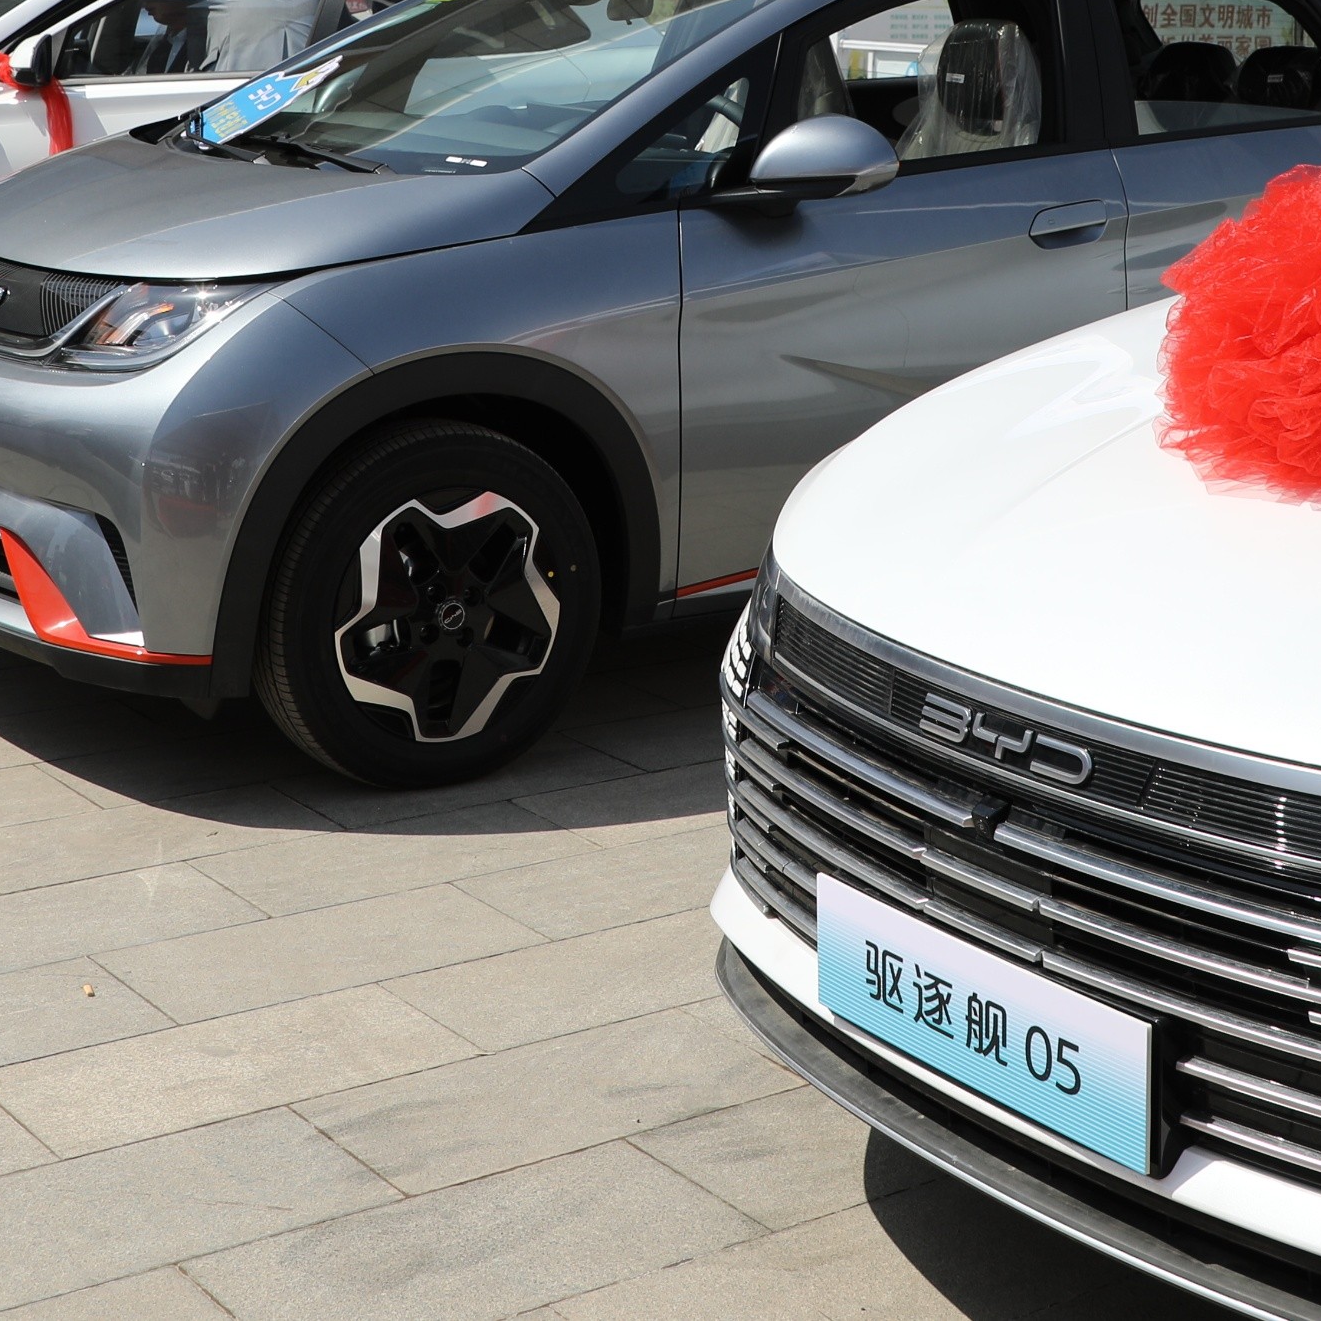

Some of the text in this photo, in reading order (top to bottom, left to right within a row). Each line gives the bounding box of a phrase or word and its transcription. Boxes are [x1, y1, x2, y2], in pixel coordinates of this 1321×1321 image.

[918, 691, 1093, 785] BYD
[864, 938, 1083, 1096] 驱逐舰05
